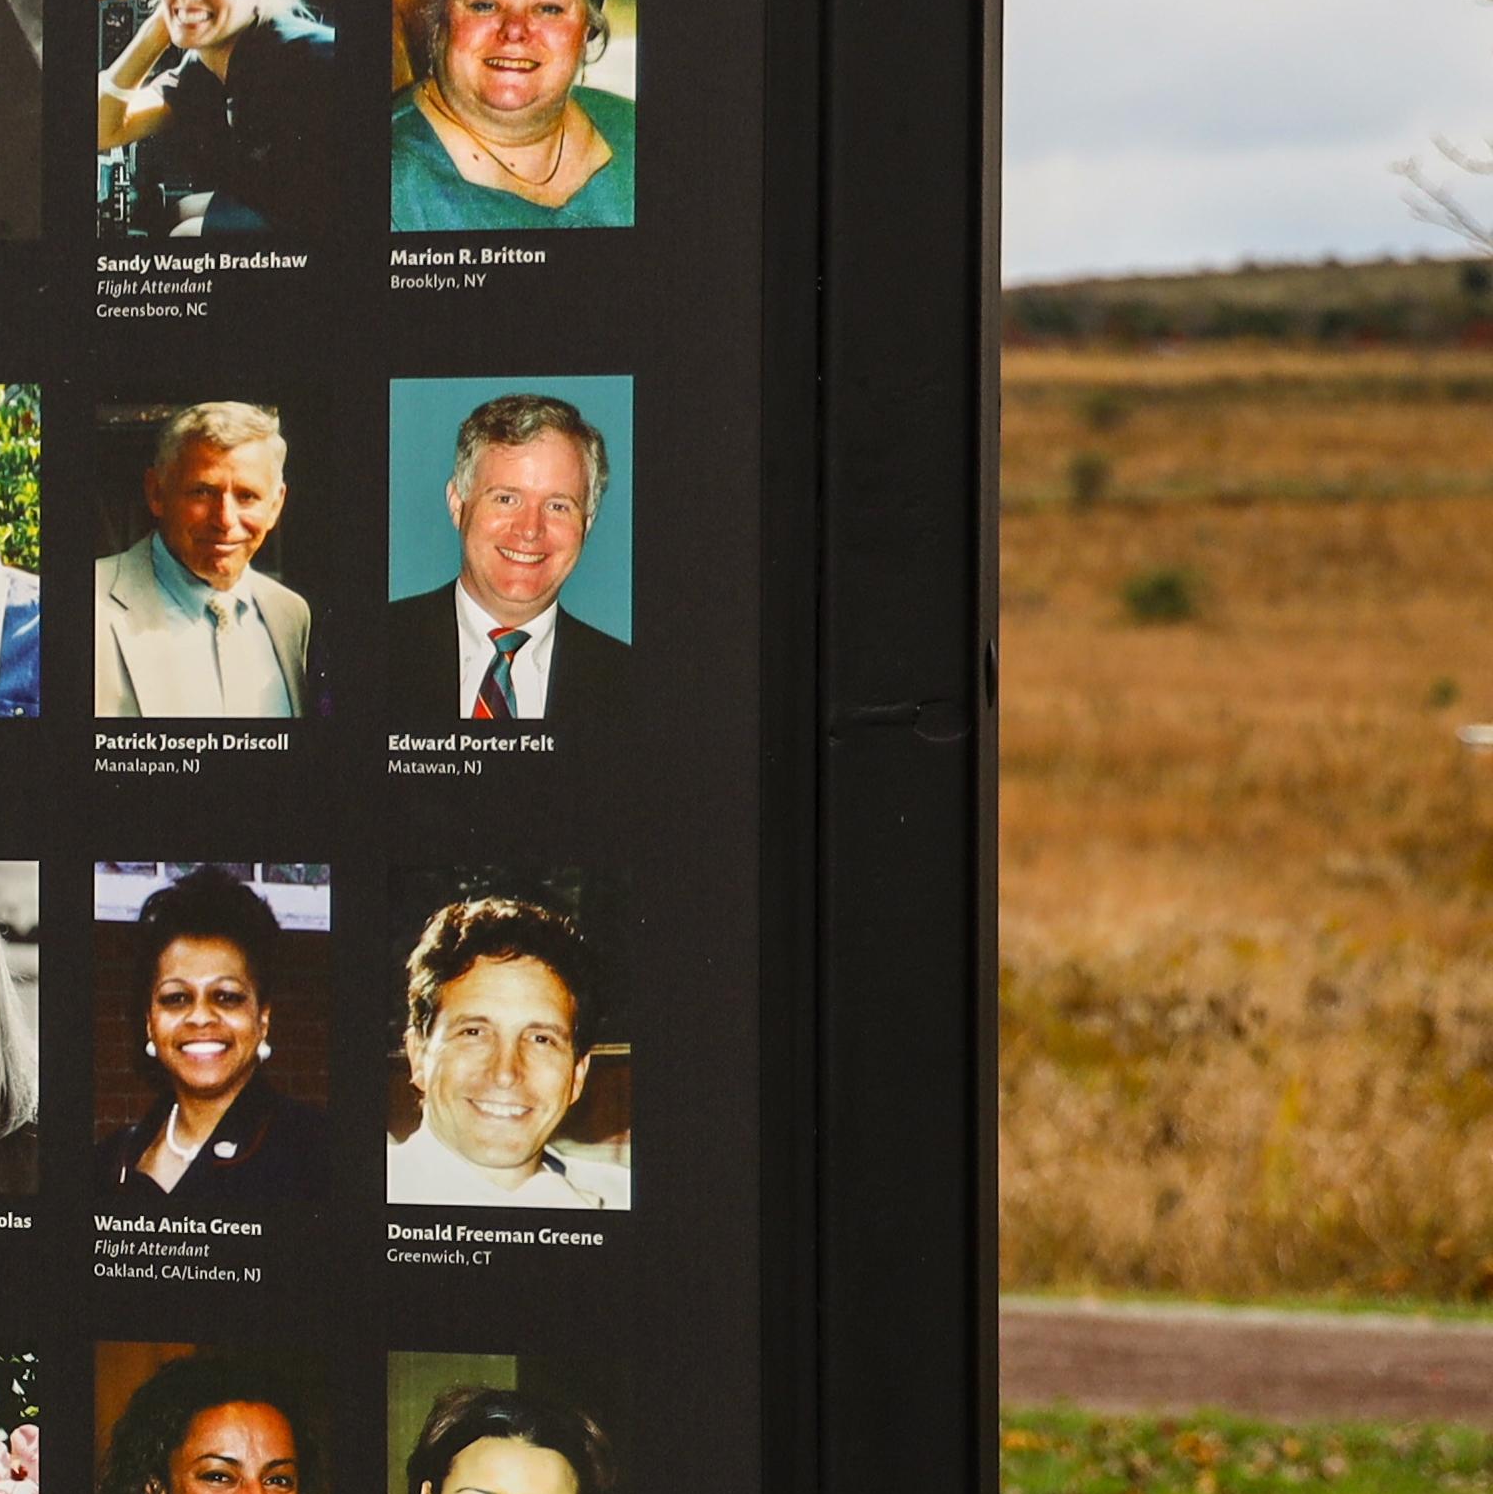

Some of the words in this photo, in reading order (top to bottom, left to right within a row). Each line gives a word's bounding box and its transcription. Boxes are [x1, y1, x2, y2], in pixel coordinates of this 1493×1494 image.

[97, 255, 151, 274] Sandy
[154, 253, 215, 274] Waugh
[220, 252, 307, 269] Bradshaw
[97, 279, 137, 298] Flight
[140, 278, 212, 294] Attendant
[97, 303, 182, 317] Greensboro,
[187, 303, 207, 315] NC
[95, 733, 157, 749] Patrick
[159, 733, 218, 753] Joseph
[223, 733, 288, 750] Driscoll
[389, 734, 456, 751] Edward
[460, 735, 517, 751] Porter
[521, 735, 554, 751] Felt
[95, 758, 179, 775] Manalapan,
[183, 759, 199, 773] NJ
[388, 760, 459, 775] Matawan,
[465, 760, 481, 775] NJ
[94, 1215, 155, 1232] Wanda
[158, 1216, 207, 1233] Anita
[211, 1219, 261, 1235] Green
[95, 1239, 135, 1257] Flight
[138, 1242, 209, 1257] Attendant
[94, 1263, 157, 1279] Oakland,
[162, 1266, 239, 1282] CA/Linden,
[245, 1268, 261, 1282] NJ
